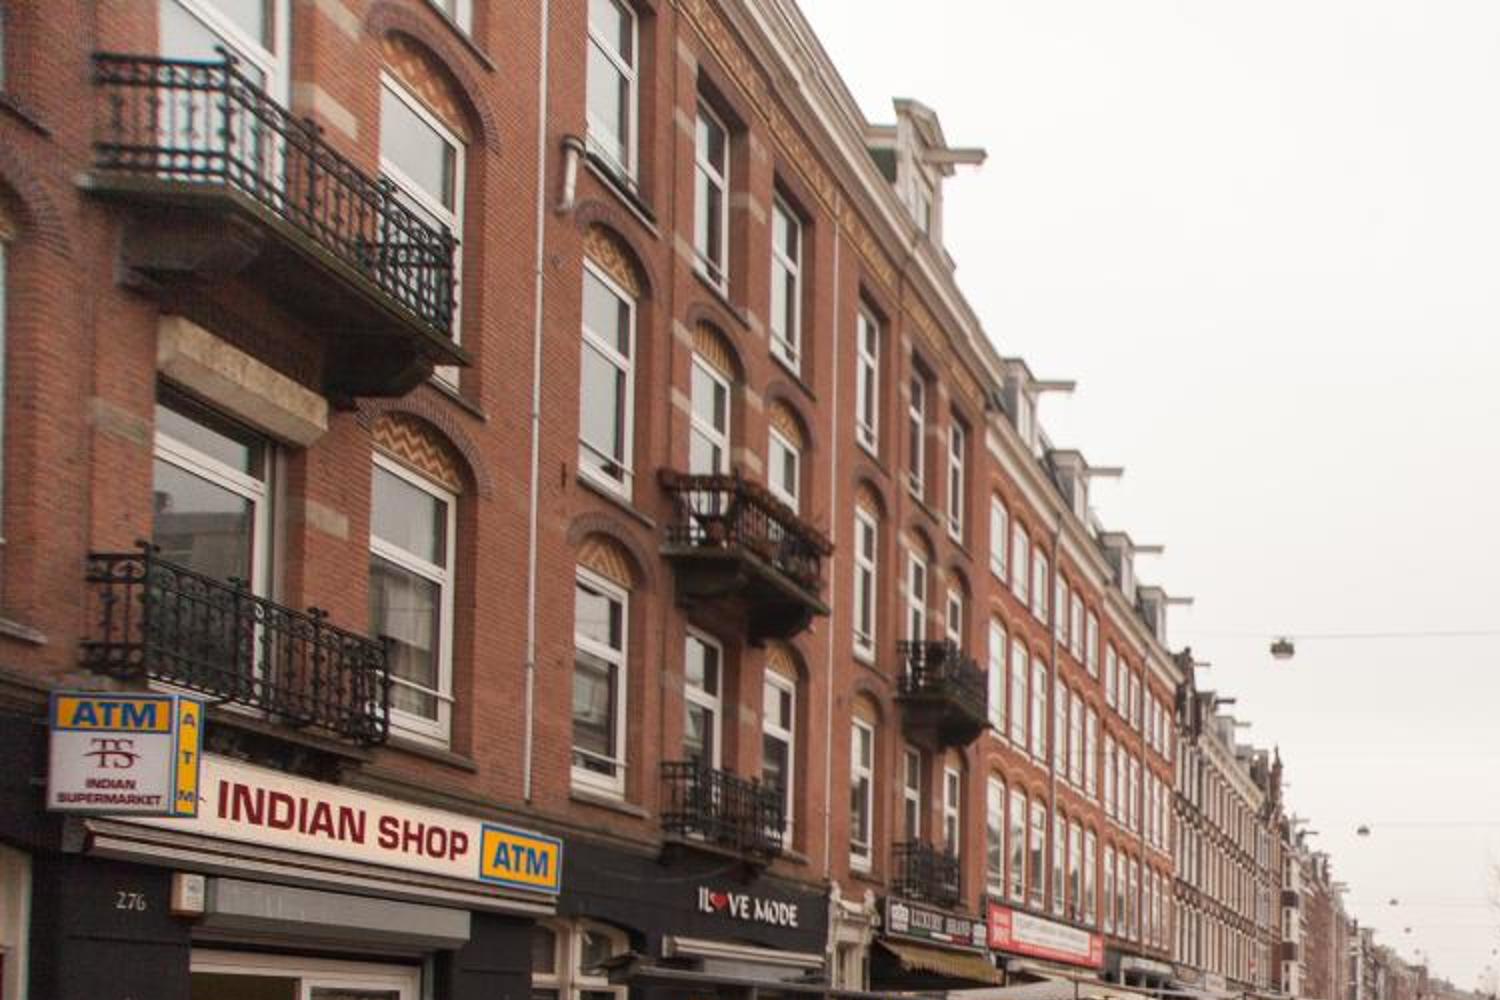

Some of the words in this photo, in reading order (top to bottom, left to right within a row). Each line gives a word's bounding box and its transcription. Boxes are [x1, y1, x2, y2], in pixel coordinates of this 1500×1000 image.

[71, 702, 157, 728] ATM
[86, 779, 137, 790] INDIAN
[57, 792, 162, 806] SUPERMARKET
[216, 779, 367, 845] INDIAN
[377, 815, 469, 861] SHOP
[492, 841, 549, 878] ATM
[116, 891, 147, 911] 276
[753, 897, 799, 928] MODE
